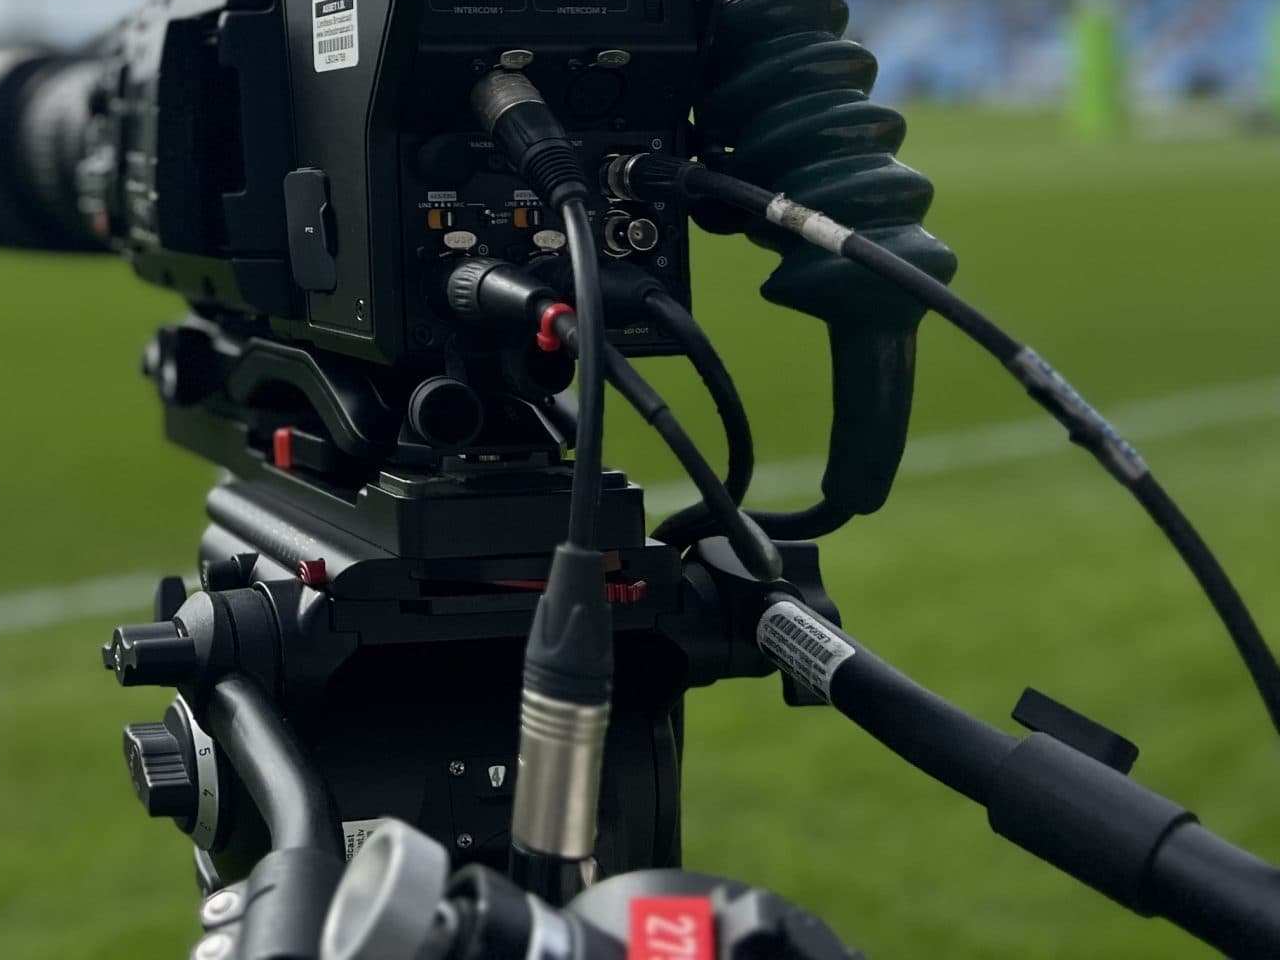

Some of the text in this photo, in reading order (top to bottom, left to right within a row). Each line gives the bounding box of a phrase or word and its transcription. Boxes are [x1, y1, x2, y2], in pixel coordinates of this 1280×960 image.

[454, 6, 497, 15] INTERCOM
[557, 7, 600, 15] INTERCOM
[198, 747, 211, 757] 5
[202, 788, 214, 798] 4
